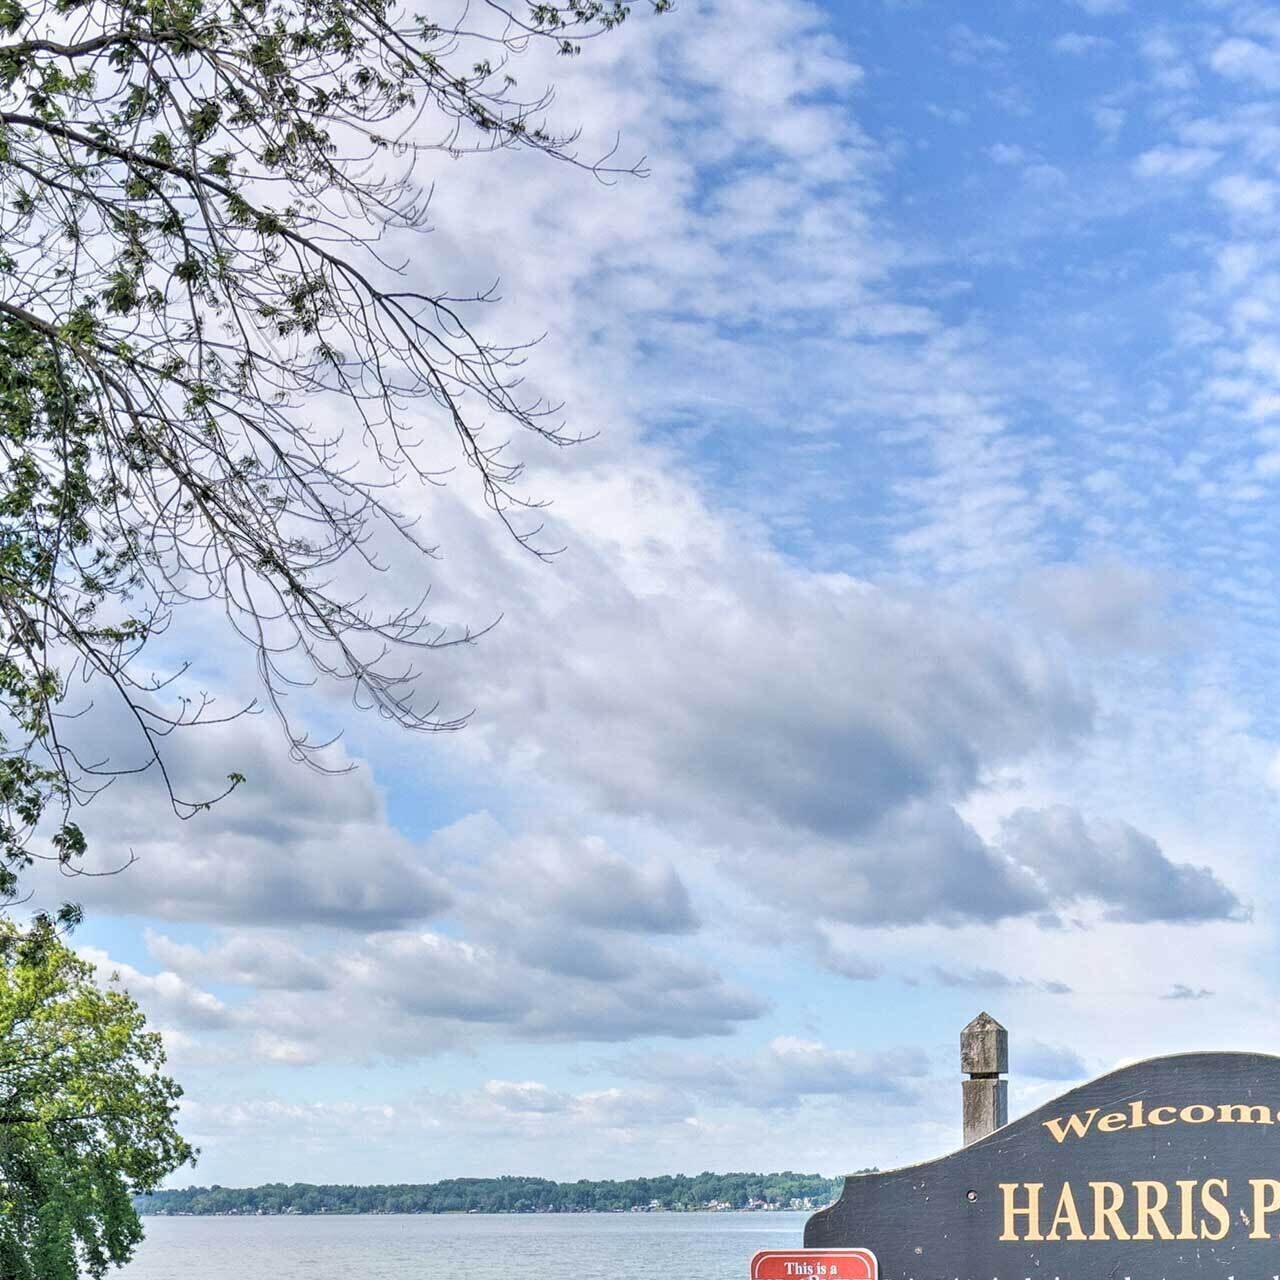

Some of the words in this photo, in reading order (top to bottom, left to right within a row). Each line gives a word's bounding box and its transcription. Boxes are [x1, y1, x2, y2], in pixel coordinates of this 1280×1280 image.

[998, 1178, 1230, 1241] HARRIS
[784, 1262, 813, 1275] This
[816, 1262, 826, 1275] is
[830, 1265, 837, 1275] a
